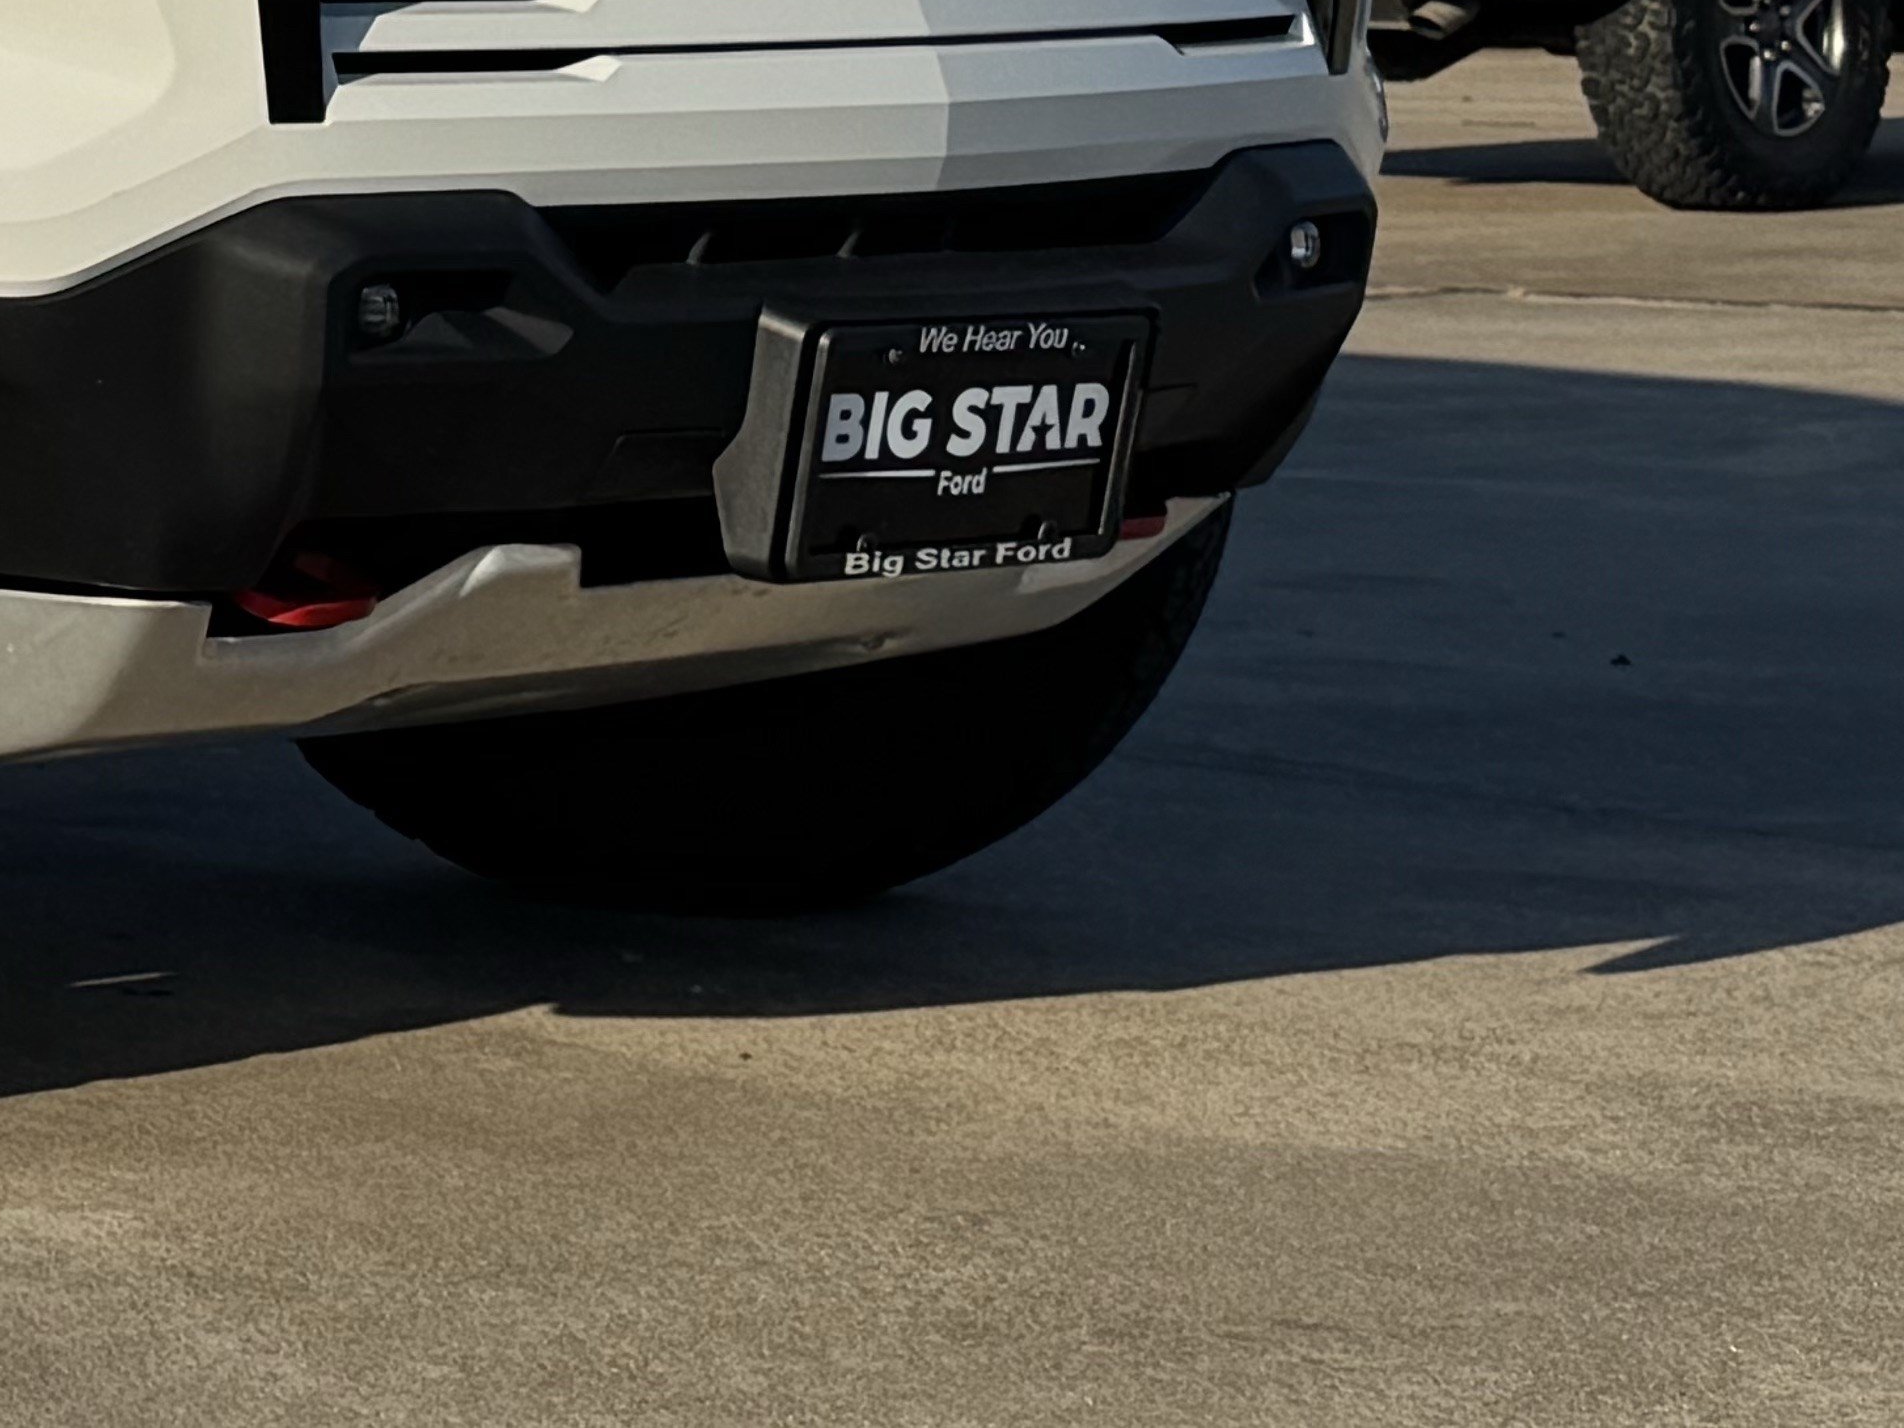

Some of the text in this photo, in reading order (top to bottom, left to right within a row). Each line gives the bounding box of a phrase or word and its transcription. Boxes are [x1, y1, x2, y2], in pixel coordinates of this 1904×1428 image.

[919, 327, 958, 354] We
[962, 326, 1022, 353] Hear
[822, 383, 1110, 462] BIG STAR
[937, 467, 988, 496] Ford
[844, 537, 1073, 577] Big Star Ford
